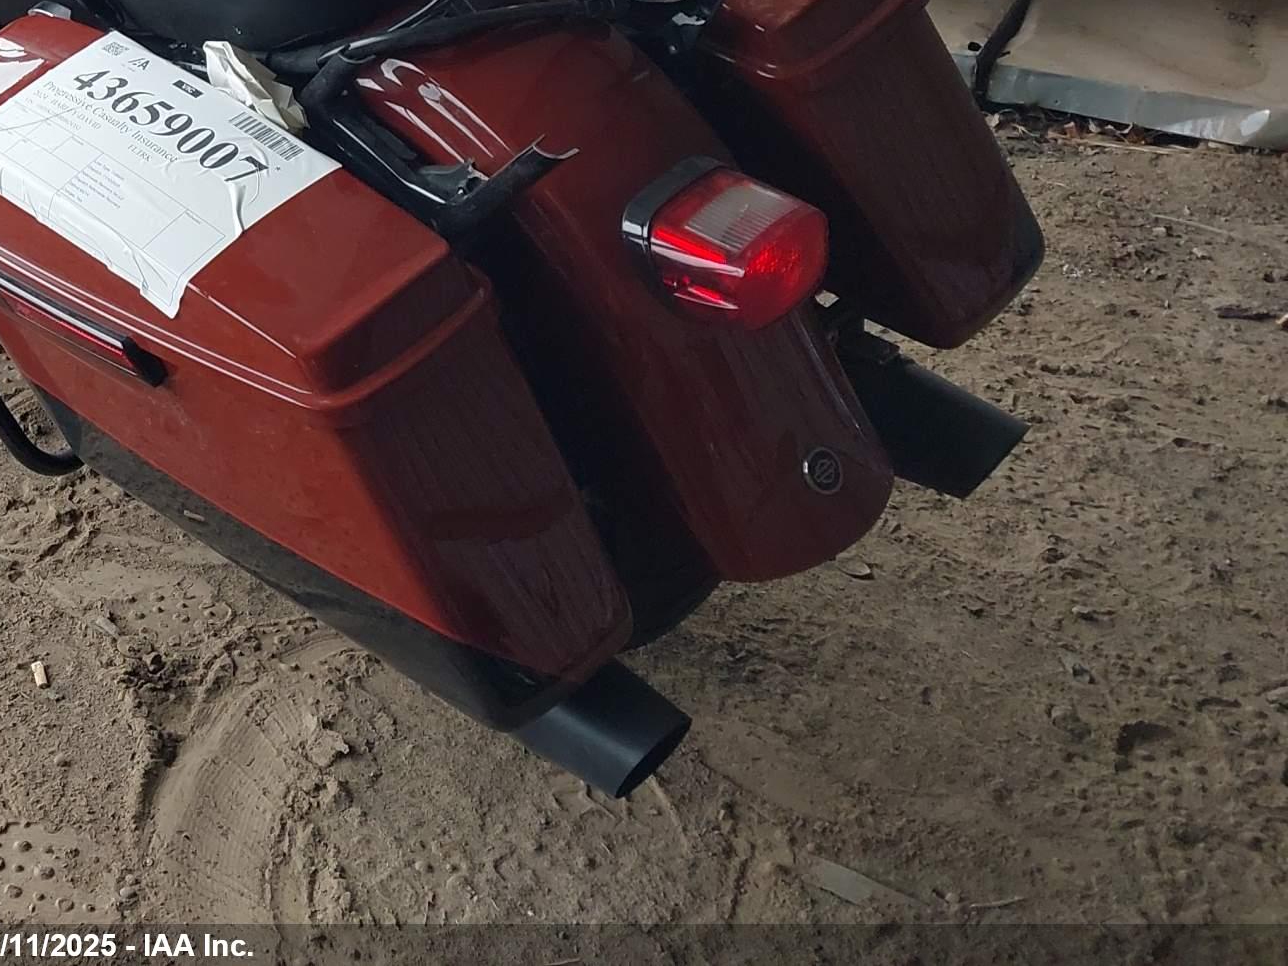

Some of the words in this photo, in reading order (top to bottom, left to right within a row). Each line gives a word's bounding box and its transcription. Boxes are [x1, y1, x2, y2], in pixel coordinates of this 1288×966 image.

[43, 81, 93, 111] Progressive
[93, 106, 131, 134] Casualty
[132, 130, 178, 163] Insurance
[73, 70, 268, 182] 43659007
